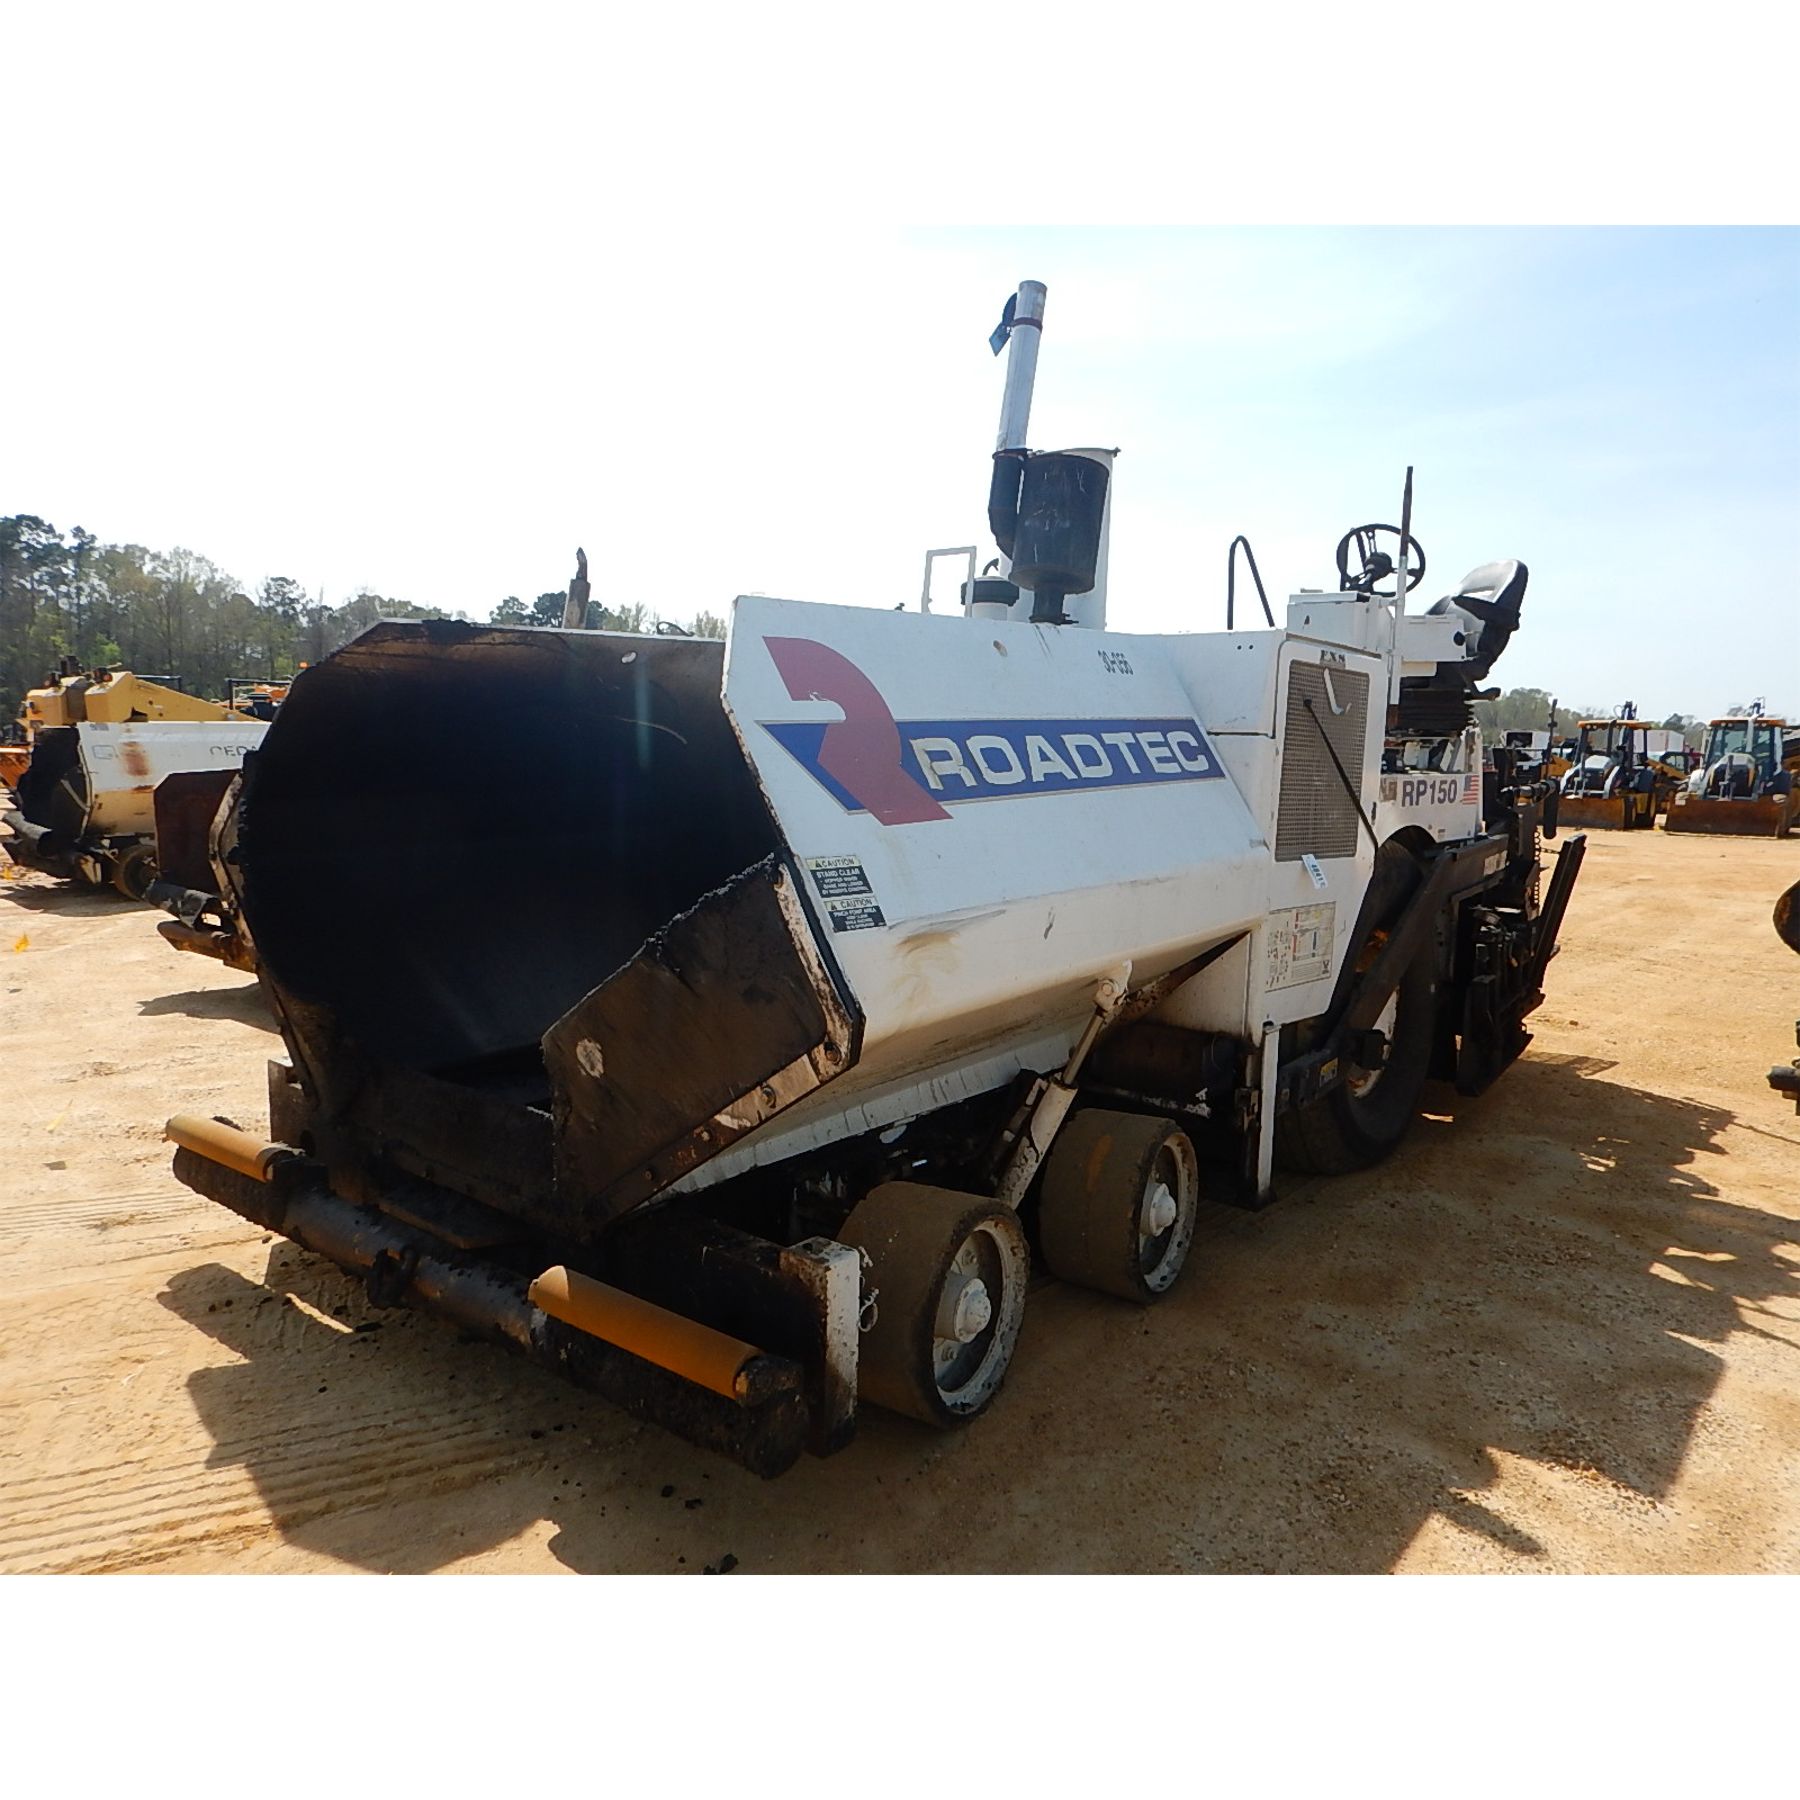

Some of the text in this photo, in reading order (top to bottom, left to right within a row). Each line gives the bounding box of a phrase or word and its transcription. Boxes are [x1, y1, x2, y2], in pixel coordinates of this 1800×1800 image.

[909, 731, 1209, 790] ROADTEC
[1401, 779, 1457, 807] RP150
[821, 858, 855, 868] CAUTION
[838, 868, 860, 876] CLEAR
[840, 898, 873, 908] CAUTION
